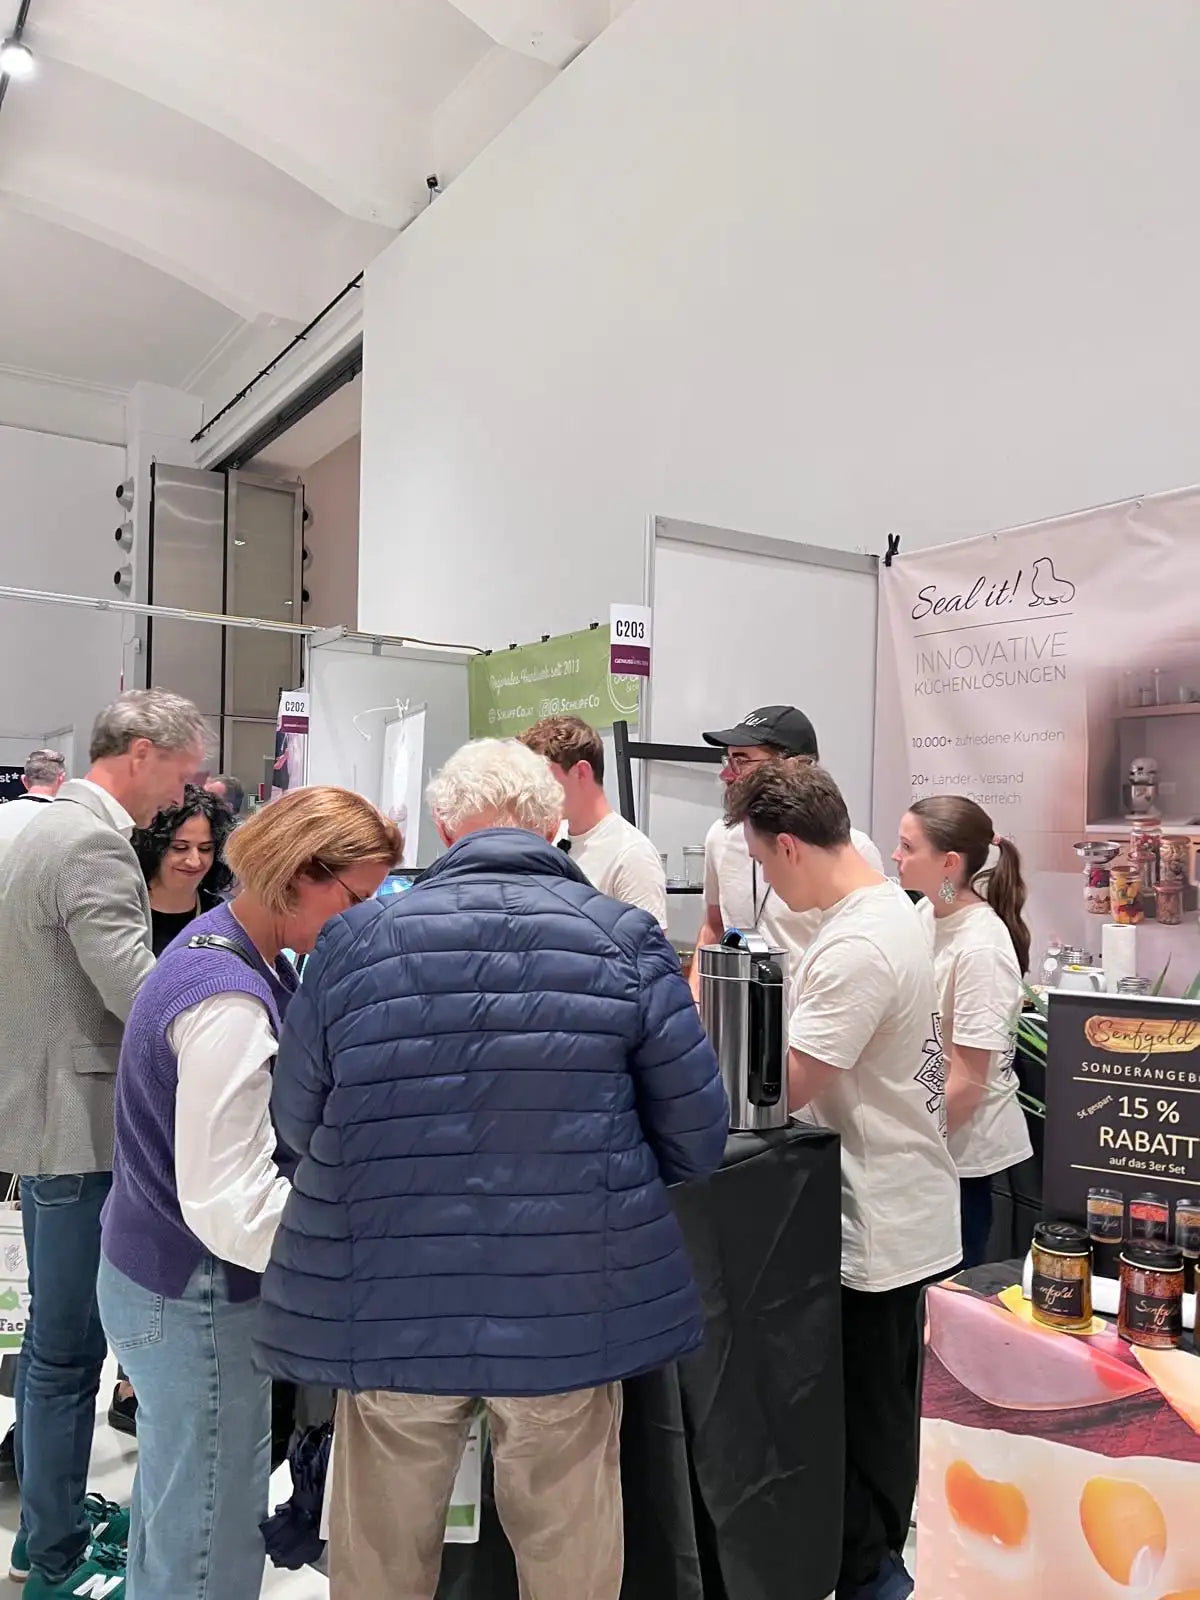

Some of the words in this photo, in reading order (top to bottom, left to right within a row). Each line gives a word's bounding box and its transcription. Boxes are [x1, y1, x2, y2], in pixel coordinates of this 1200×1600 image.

[911, 576, 985, 620] Seal
[985, 570, 1022, 606] it!
[616, 620, 645, 639] C203
[915, 632, 1068, 676] INNOVATIVE
[563, 659, 580, 675] 2013
[285, 701, 305, 713] C202
[912, 736, 952, 749] 10.000+
[1013, 729, 1065, 744] Kunden
[911, 774, 929, 786] 20+
[980, 772, 1024, 785] Versand
[1093, 1019, 1197, 1062] Senfgold
[1081, 1061, 1200, 1084] SONDERANGEB
[1086, 1095, 1114, 1115] gespart
[1118, 1096, 1149, 1119] 15
[1156, 1100, 1180, 1124] %
[1099, 1126, 1200, 1159] RABATT
[1109, 1156, 1127, 1166] auf
[1128, 1159, 1147, 1169] das
[1149, 1161, 1167, 1172] 3er
[1168, 1163, 1186, 1175] Set
[1037, 1285, 1075, 1305] enfgold
[0, 1318, 26, 1331] Fac
